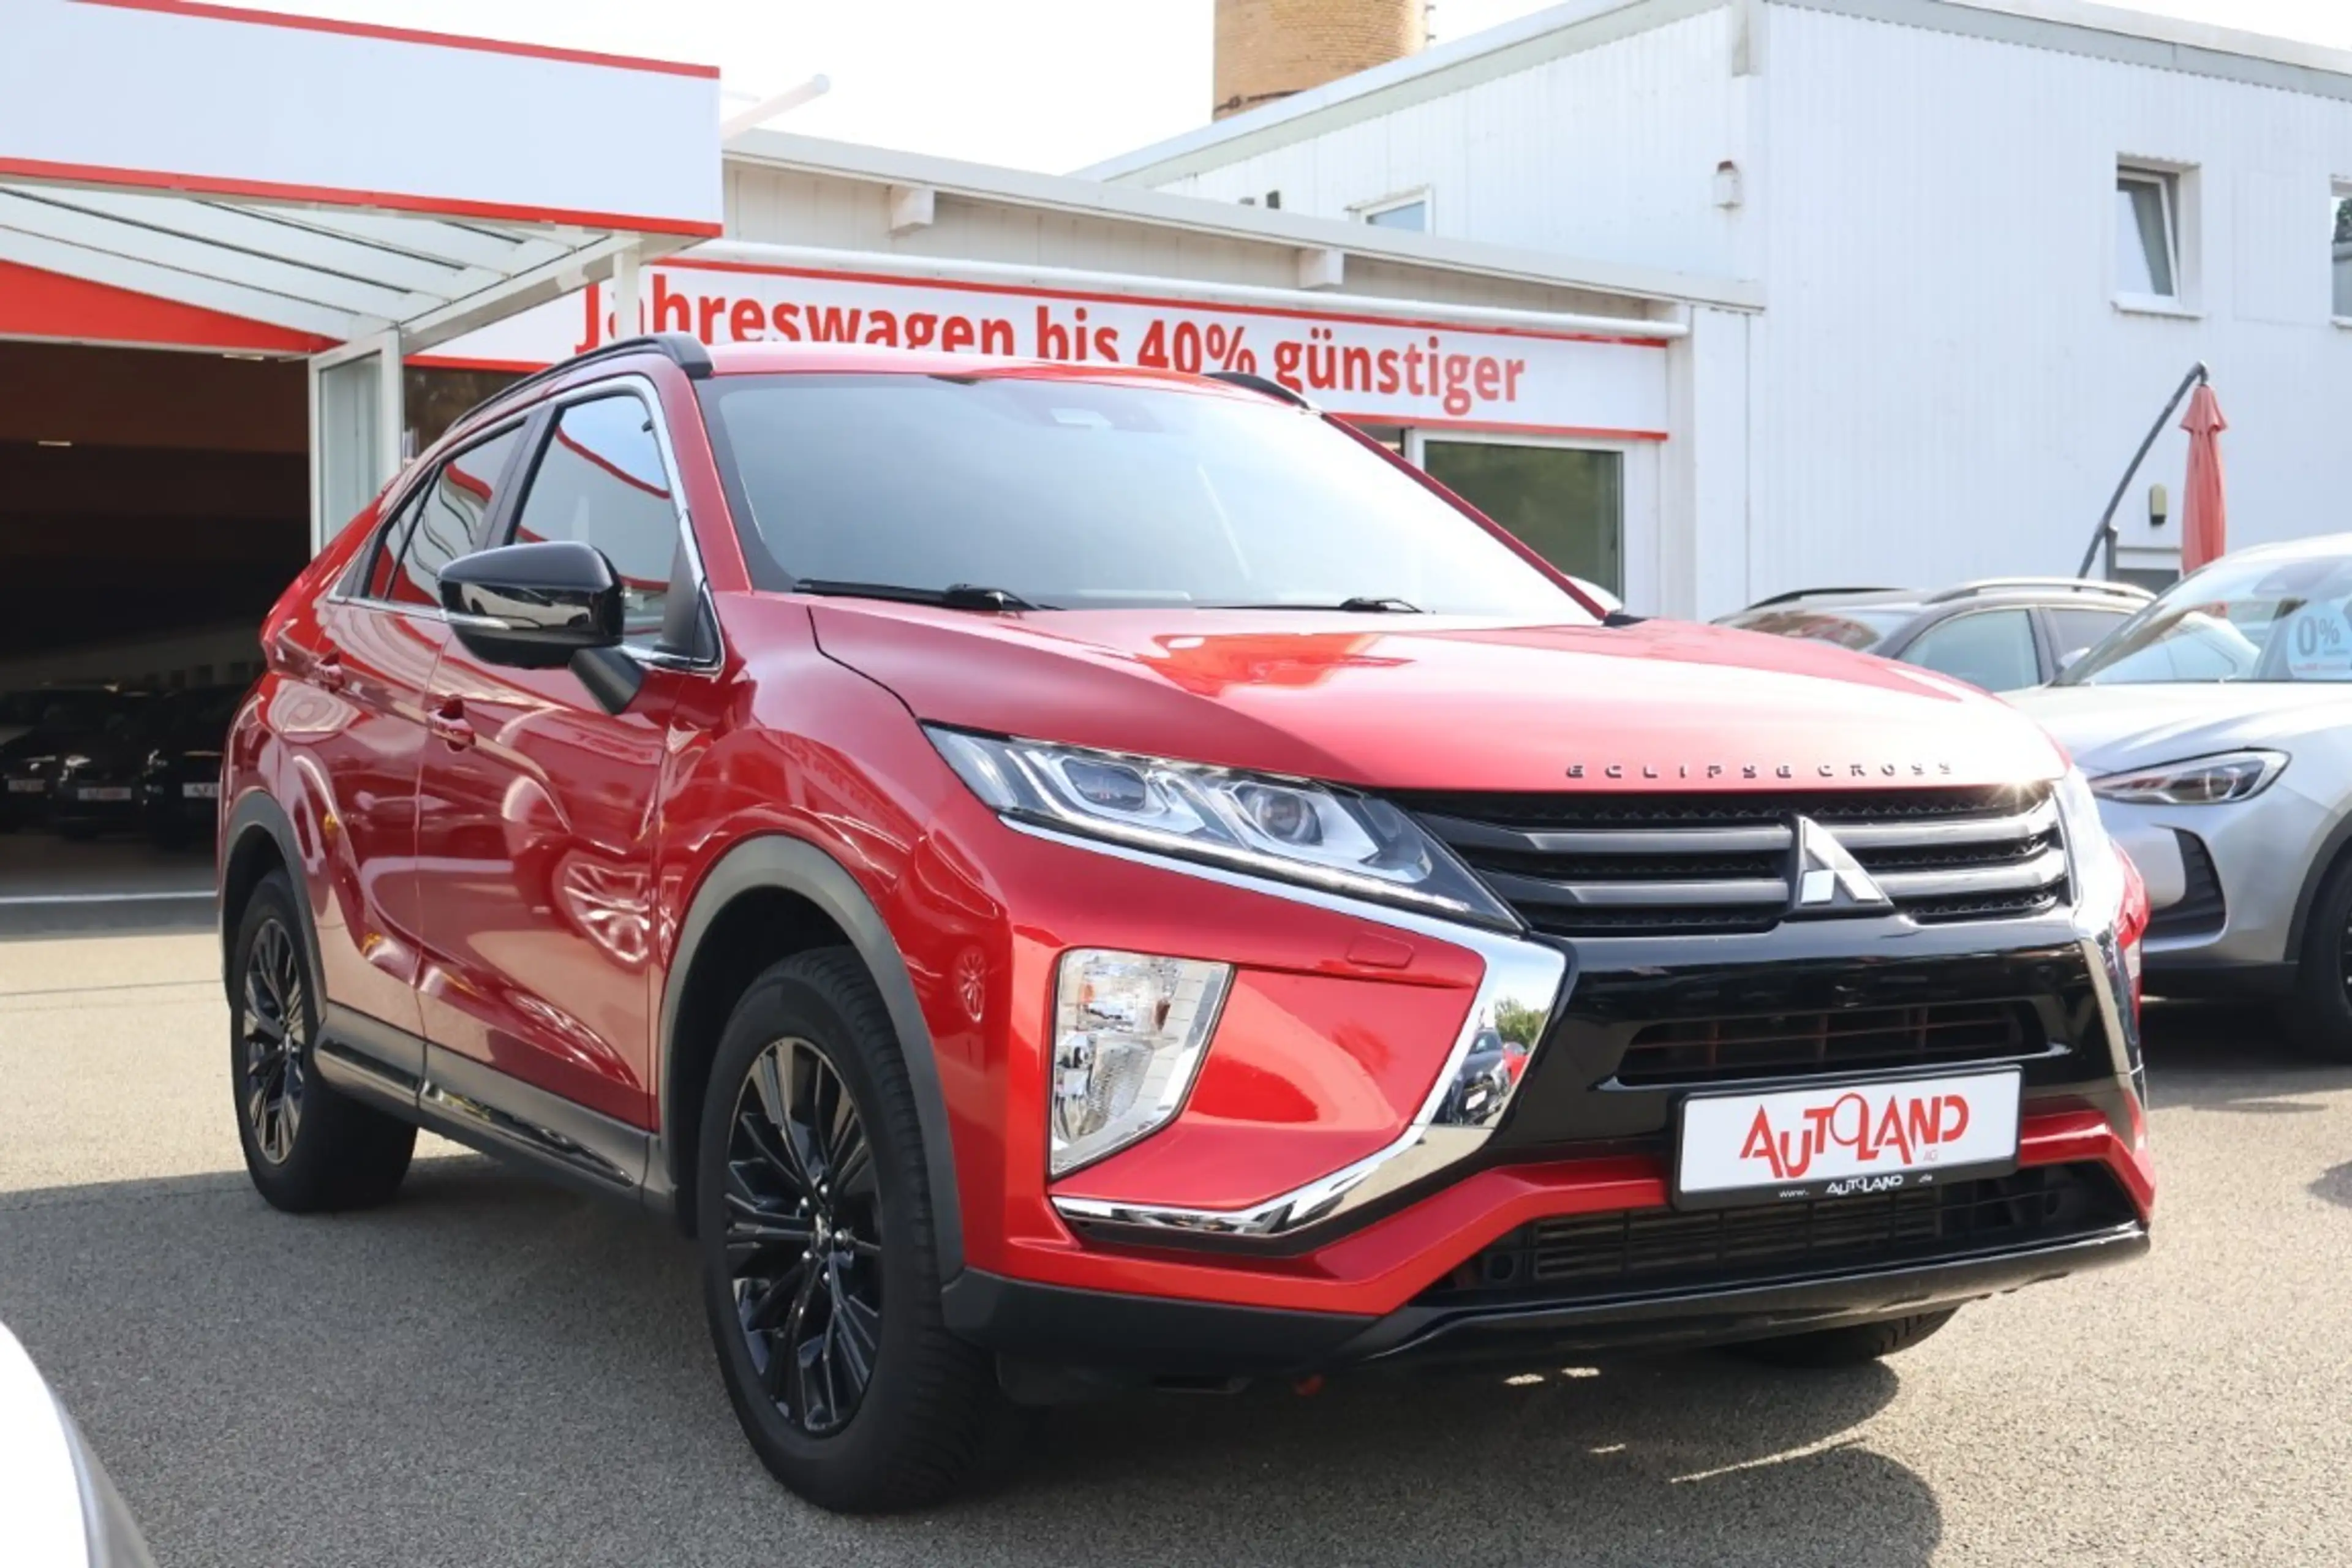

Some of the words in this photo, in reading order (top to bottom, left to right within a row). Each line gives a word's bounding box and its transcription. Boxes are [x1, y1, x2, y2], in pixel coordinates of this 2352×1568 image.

[575, 273, 1014, 356] Jhreswagen
[1036, 305, 1118, 362] bis
[1137, 319, 1256, 375] 40%
[1273, 327, 1525, 416] günstiger
[2296, 615, 2341, 657] 0%
[1566, 765, 1792, 780] ECLIPSE
[1817, 763, 1951, 777] CROSS
